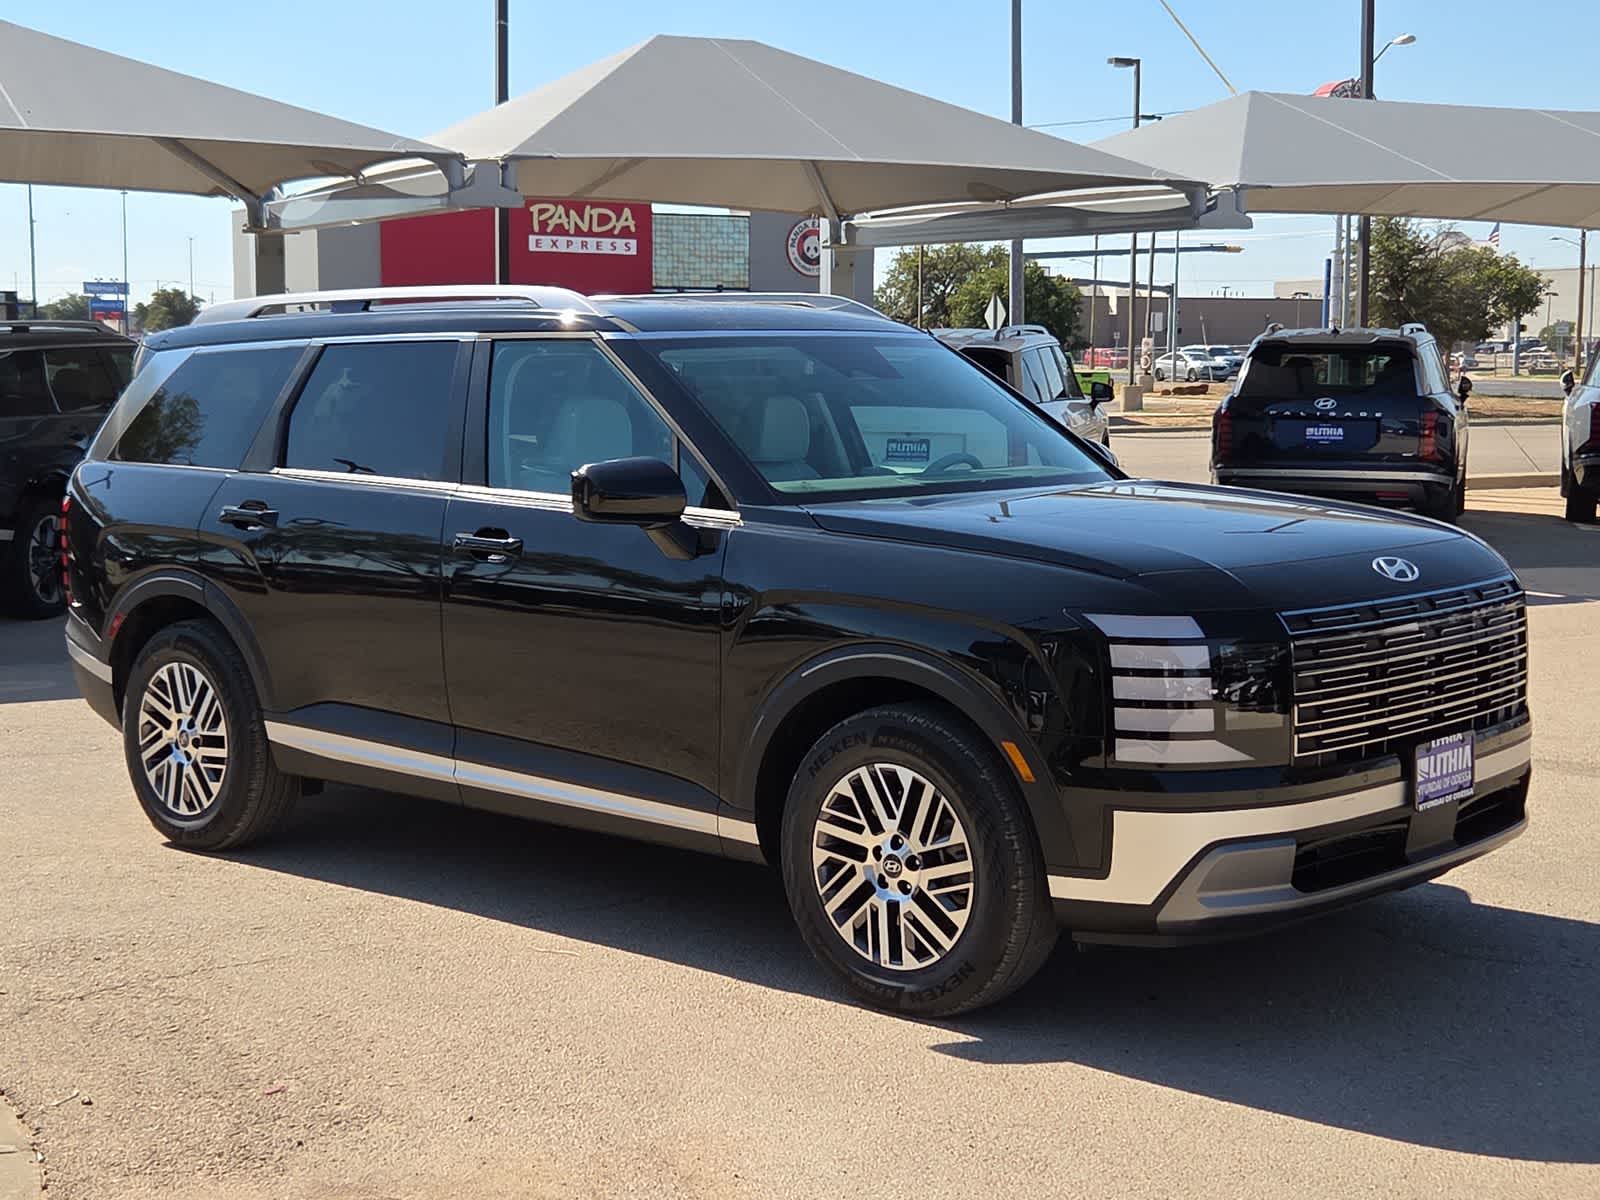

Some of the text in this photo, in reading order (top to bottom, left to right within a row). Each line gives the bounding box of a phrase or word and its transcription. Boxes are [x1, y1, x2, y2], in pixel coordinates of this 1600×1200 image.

[530, 203, 636, 235] PANDA
[535, 239, 632, 251] EXPRESS
[1314, 427, 1344, 436] LITHIA
[808, 730, 867, 777] NEXEN
[1429, 745, 1472, 778] LITHIA
